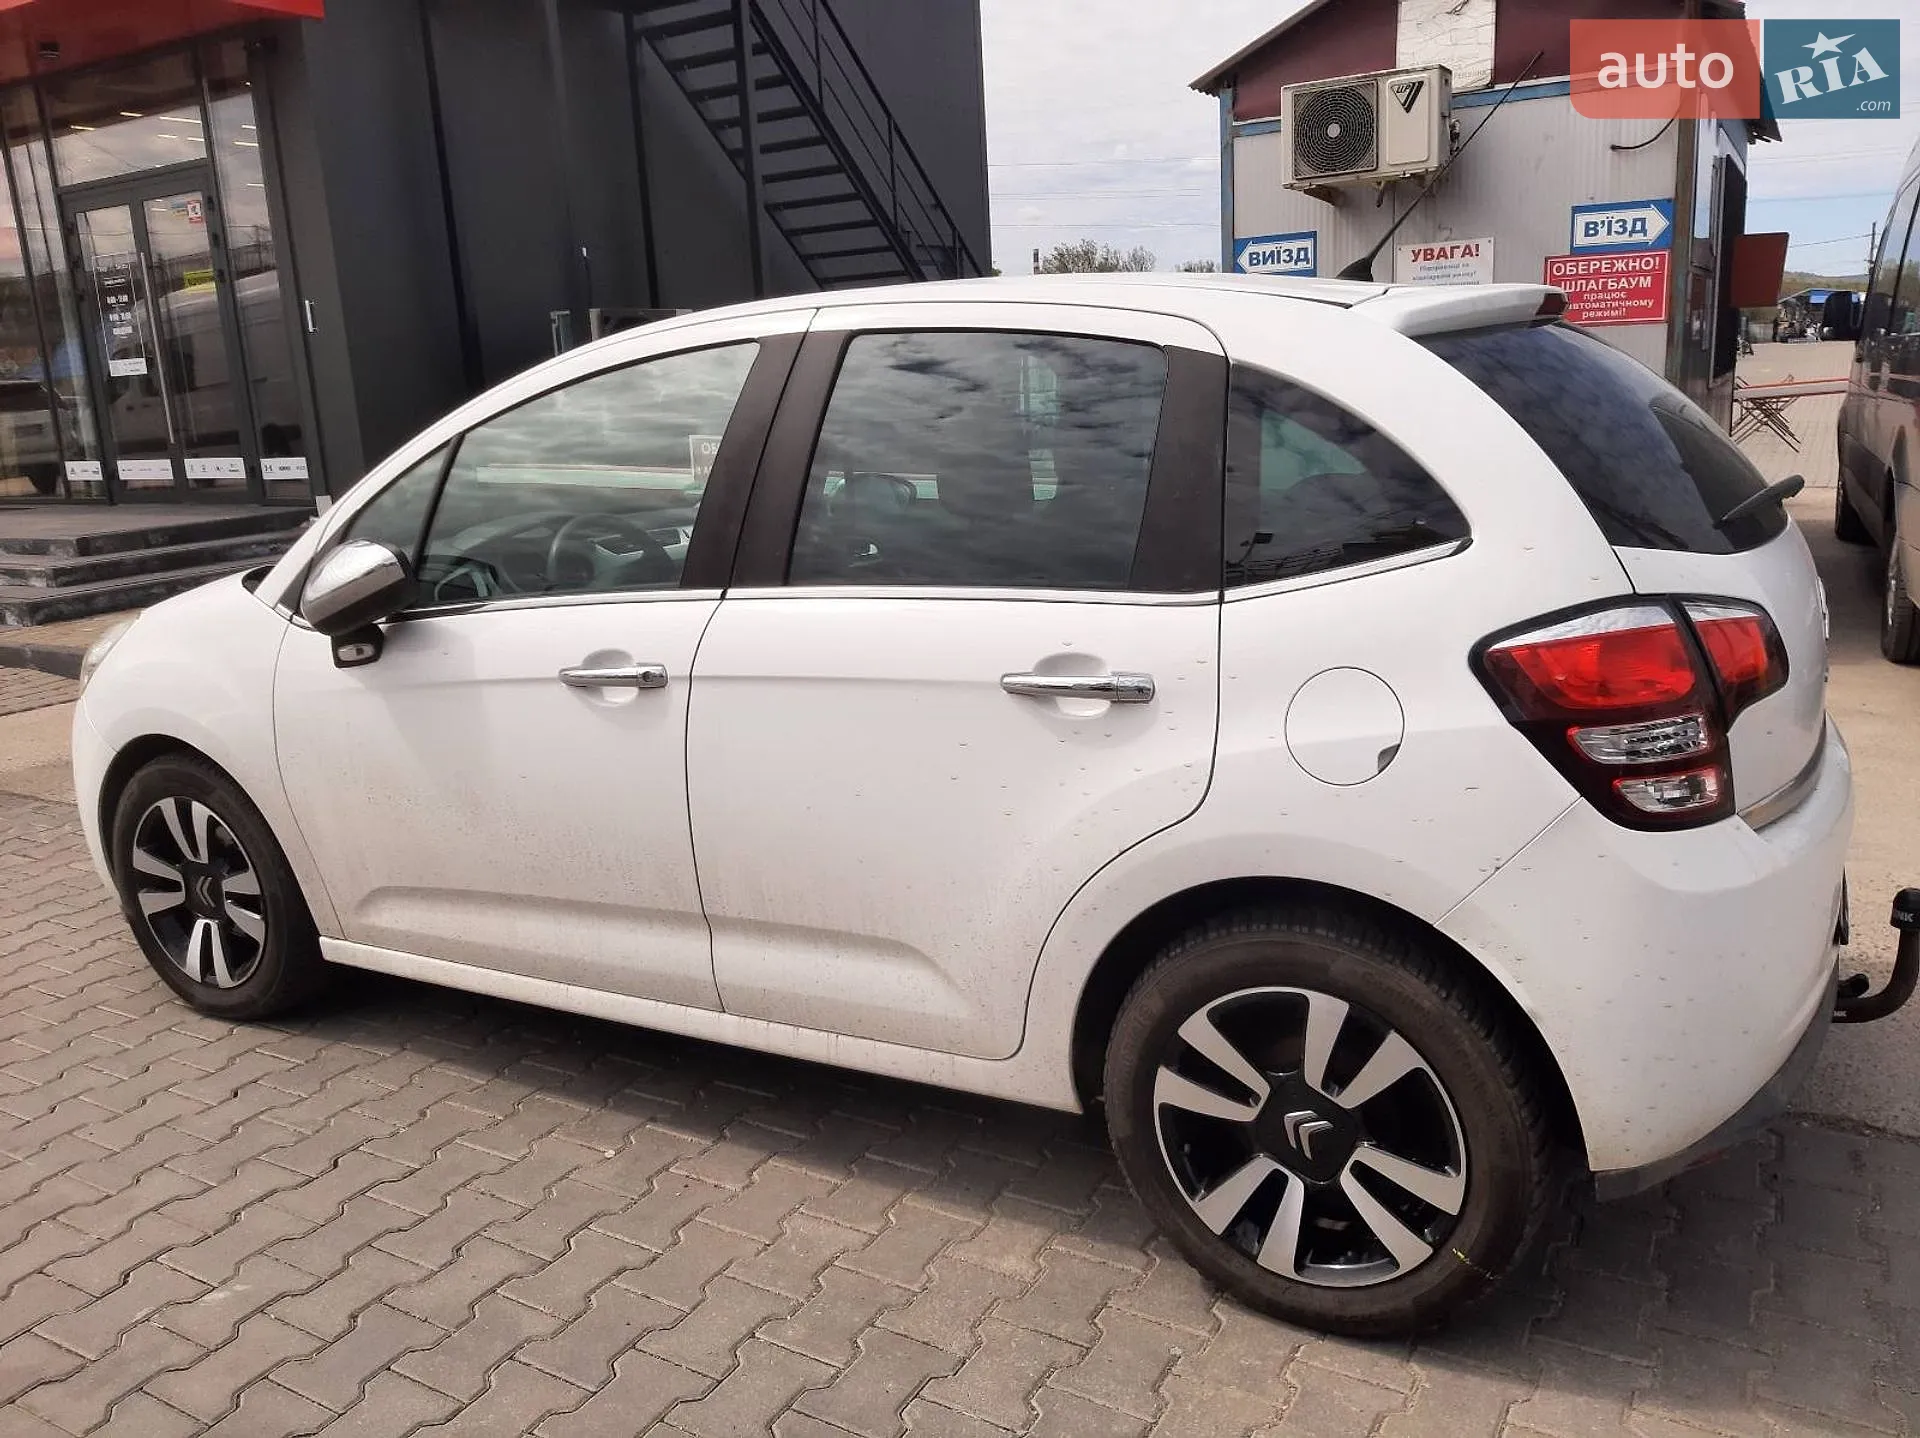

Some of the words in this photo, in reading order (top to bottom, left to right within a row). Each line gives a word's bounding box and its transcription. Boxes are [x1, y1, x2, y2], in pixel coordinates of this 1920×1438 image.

[1584, 216, 1648, 238] В'ЇЗД
[1248, 246, 1310, 266] ВИЇЗД
[1411, 243, 1480, 262] УВАГА!
[1552, 256, 1660, 276] ОБЕРЕЖНО!
[1561, 276, 1652, 293] ШЛАГБАУМ
[1583, 291, 1627, 301] працює
[1582, 308, 1627, 319] режимі!
